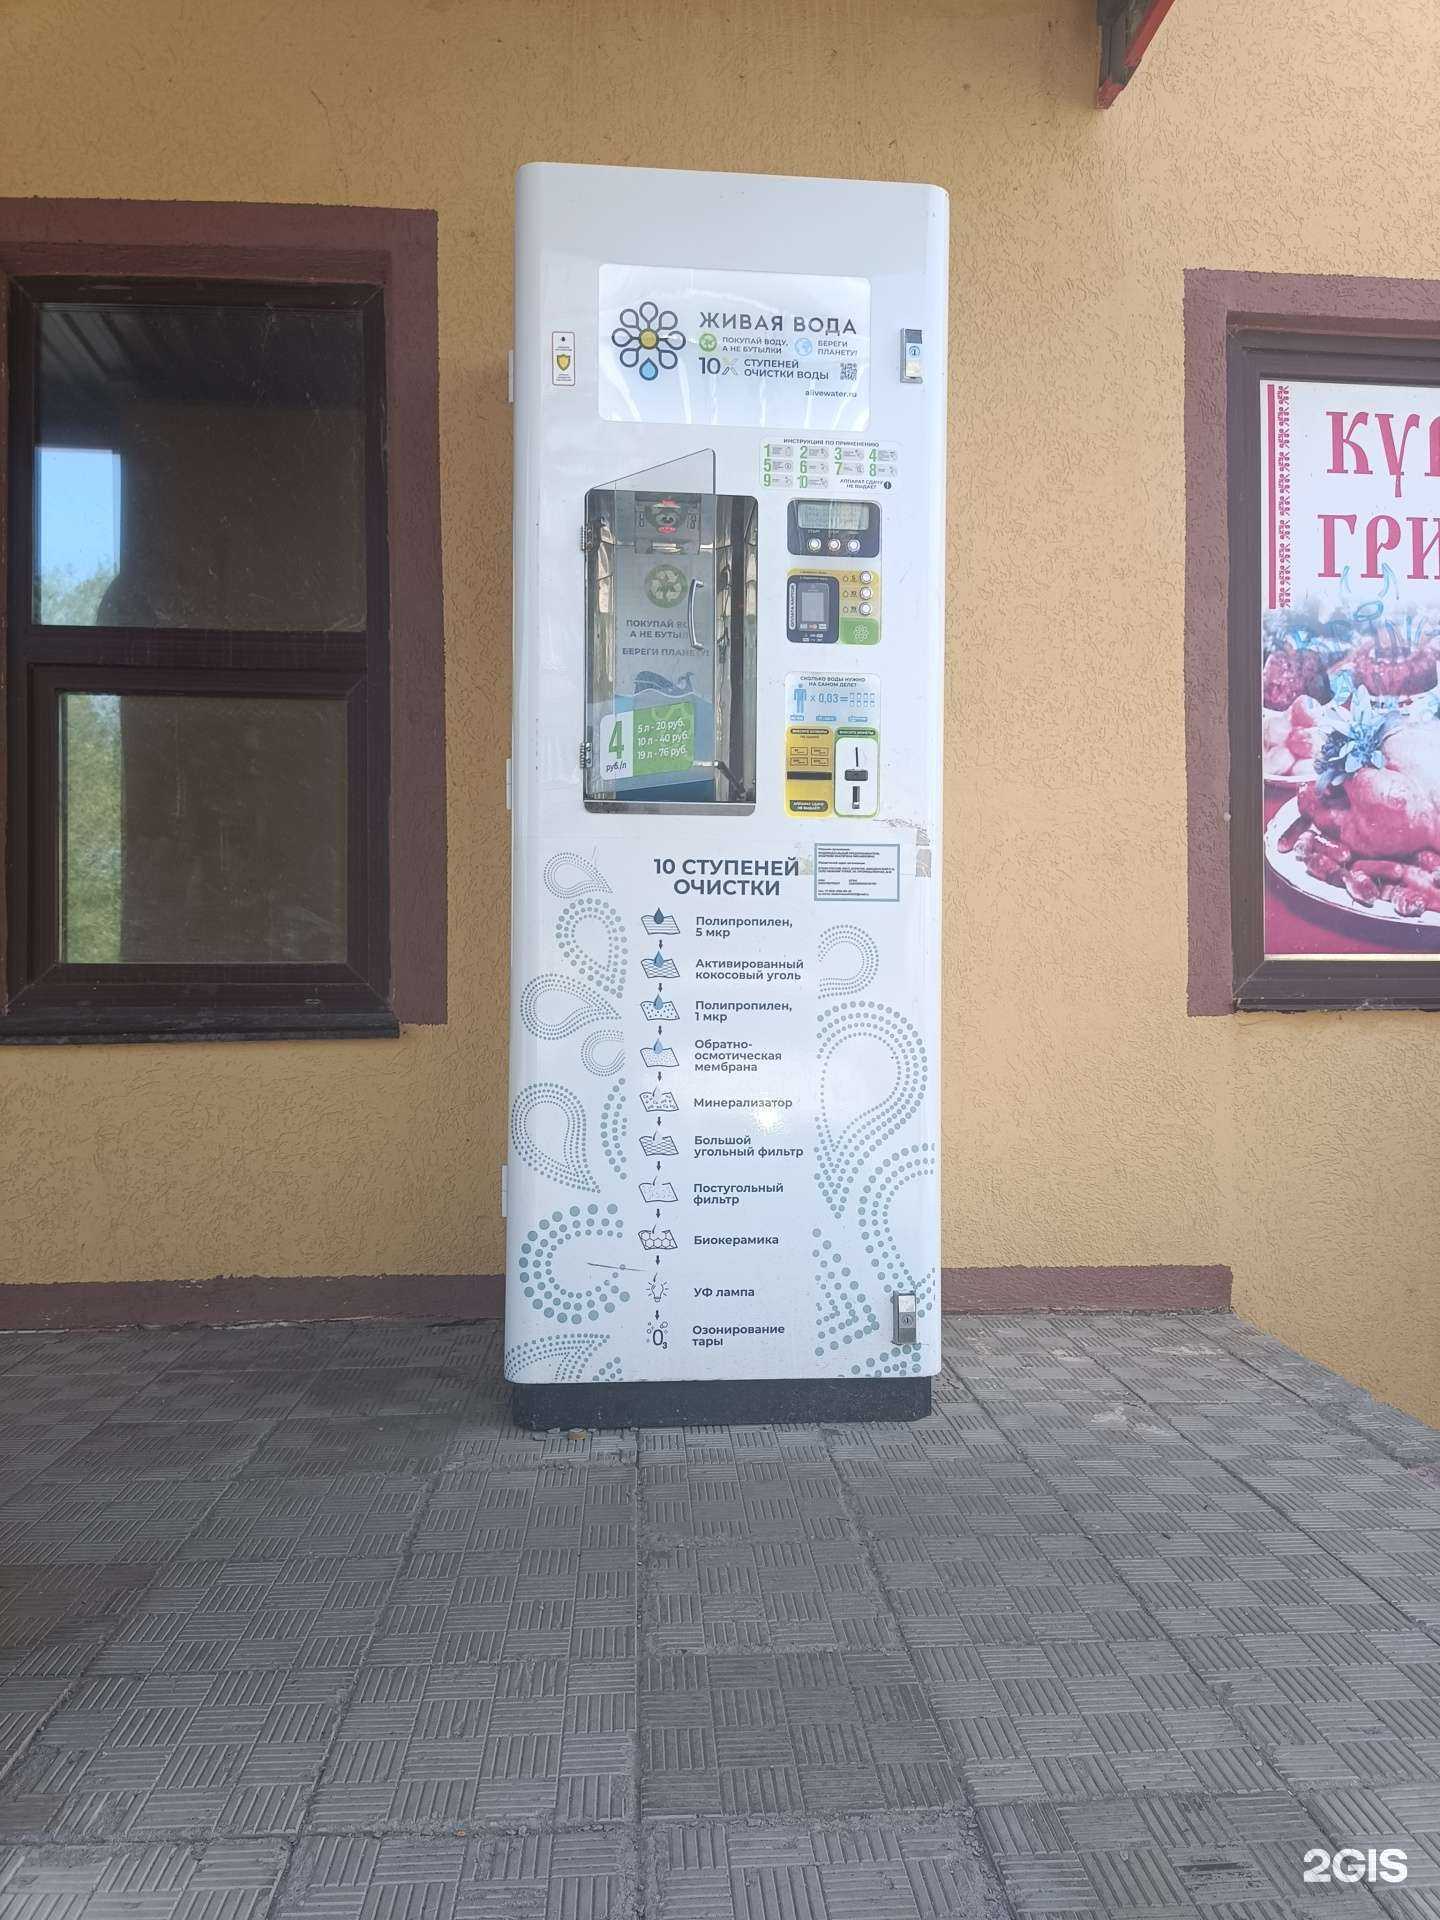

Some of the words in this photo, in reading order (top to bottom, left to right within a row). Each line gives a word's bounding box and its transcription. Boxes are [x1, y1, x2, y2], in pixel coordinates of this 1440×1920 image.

[699, 312, 783, 331] ЖИВАЯ
[793, 316, 857, 336] ВОДА
[722, 336, 762, 346] ПОКУПАЙ
[764, 338, 789, 347] ВОДУ,
[743, 346, 782, 354] БУТЫЛКИ
[818, 348, 858, 356] ПЛАНЕТУ!
[744, 358, 799, 368] СТУПЕНЕЙ
[744, 369, 794, 378] ОЧИСТКИ
[797, 371, 829, 380] ВОДЫ
[764, 444, 770, 457] 1
[800, 446, 808, 459] 2
[834, 447, 842, 460] 3
[869, 448, 877, 462] 4
[764, 459, 771, 472] 5
[800, 460, 808, 474] 6
[834, 462, 842, 475] 7
[869, 464, 876, 476] 8
[764, 474, 770, 486] 9
[797, 475, 808, 488] 10
[626, 619, 674, 628] ПОКУПАЙ
[630, 630, 636, 638] А
[622, 648, 659, 656] БЕРЕГИ
[638, 724, 642, 734] 5
[644, 725, 650, 733] л
[656, 721, 666, 730] 20
[608, 720, 624, 759] 4
[638, 737, 646, 746] 10
[647, 737, 653, 745] л
[660, 734, 670, 742] 40
[638, 750, 646, 760] 19
[658, 748, 669, 757] 76
[654, 858, 676, 874] 10
[682, 856, 799, 876] СТУПЕНЕЙ
[674, 880, 780, 896] ОЧИСТКИ
[696, 916, 793, 928] Полипропилен,
[696, 928, 702, 936] 5
[706, 929, 730, 938] мкр
[696, 959, 804, 970] Активированный
[696, 970, 764, 980] кокосовый
[766, 972, 801, 982] уголь
[696, 1001, 792, 1012] Полипропилен,
[695, 1012, 700, 1021] 1
[704, 1013, 728, 1023] мкр
[695, 1040, 752, 1050] Обратно-
[695, 1052, 782, 1060] осмотическая
[695, 1062, 758, 1073] мембрана
[694, 1098, 792, 1110] Минерализатор
[694, 1135, 751, 1144] Большой
[694, 1147, 754, 1158] угольный
[758, 1148, 804, 1158] фильтр
[694, 1183, 784, 1194] Постугольный
[694, 1195, 739, 1206] фильтр
[694, 1236, 778, 1246] Биокерамика
[694, 1288, 712, 1298] УФ
[692, 1326, 785, 1336] Озонирование
[692, 1338, 724, 1348] тары
